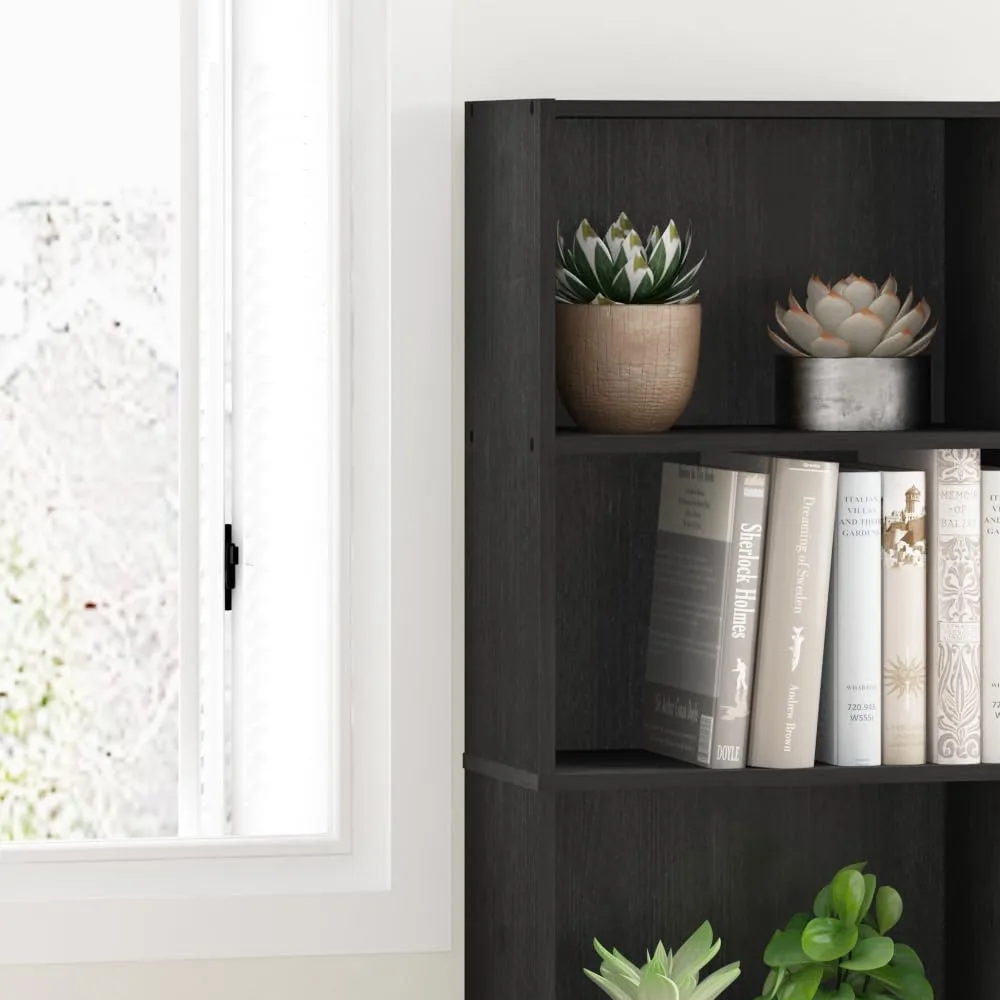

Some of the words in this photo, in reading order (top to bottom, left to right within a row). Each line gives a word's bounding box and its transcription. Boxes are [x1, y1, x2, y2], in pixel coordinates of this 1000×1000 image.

[795, 496, 816, 552] Dreaming
[840, 518, 859, 526] AND
[847, 506, 877, 514] VILLAS
[736, 523, 762, 584] Sherlock
[798, 555, 811, 569] of
[793, 569, 809, 614] Sweden
[731, 587, 757, 639] Holmes
[786, 684, 799, 719] Andrew
[717, 744, 740, 761] DOYLE
[783, 722, 797, 752] Brown
